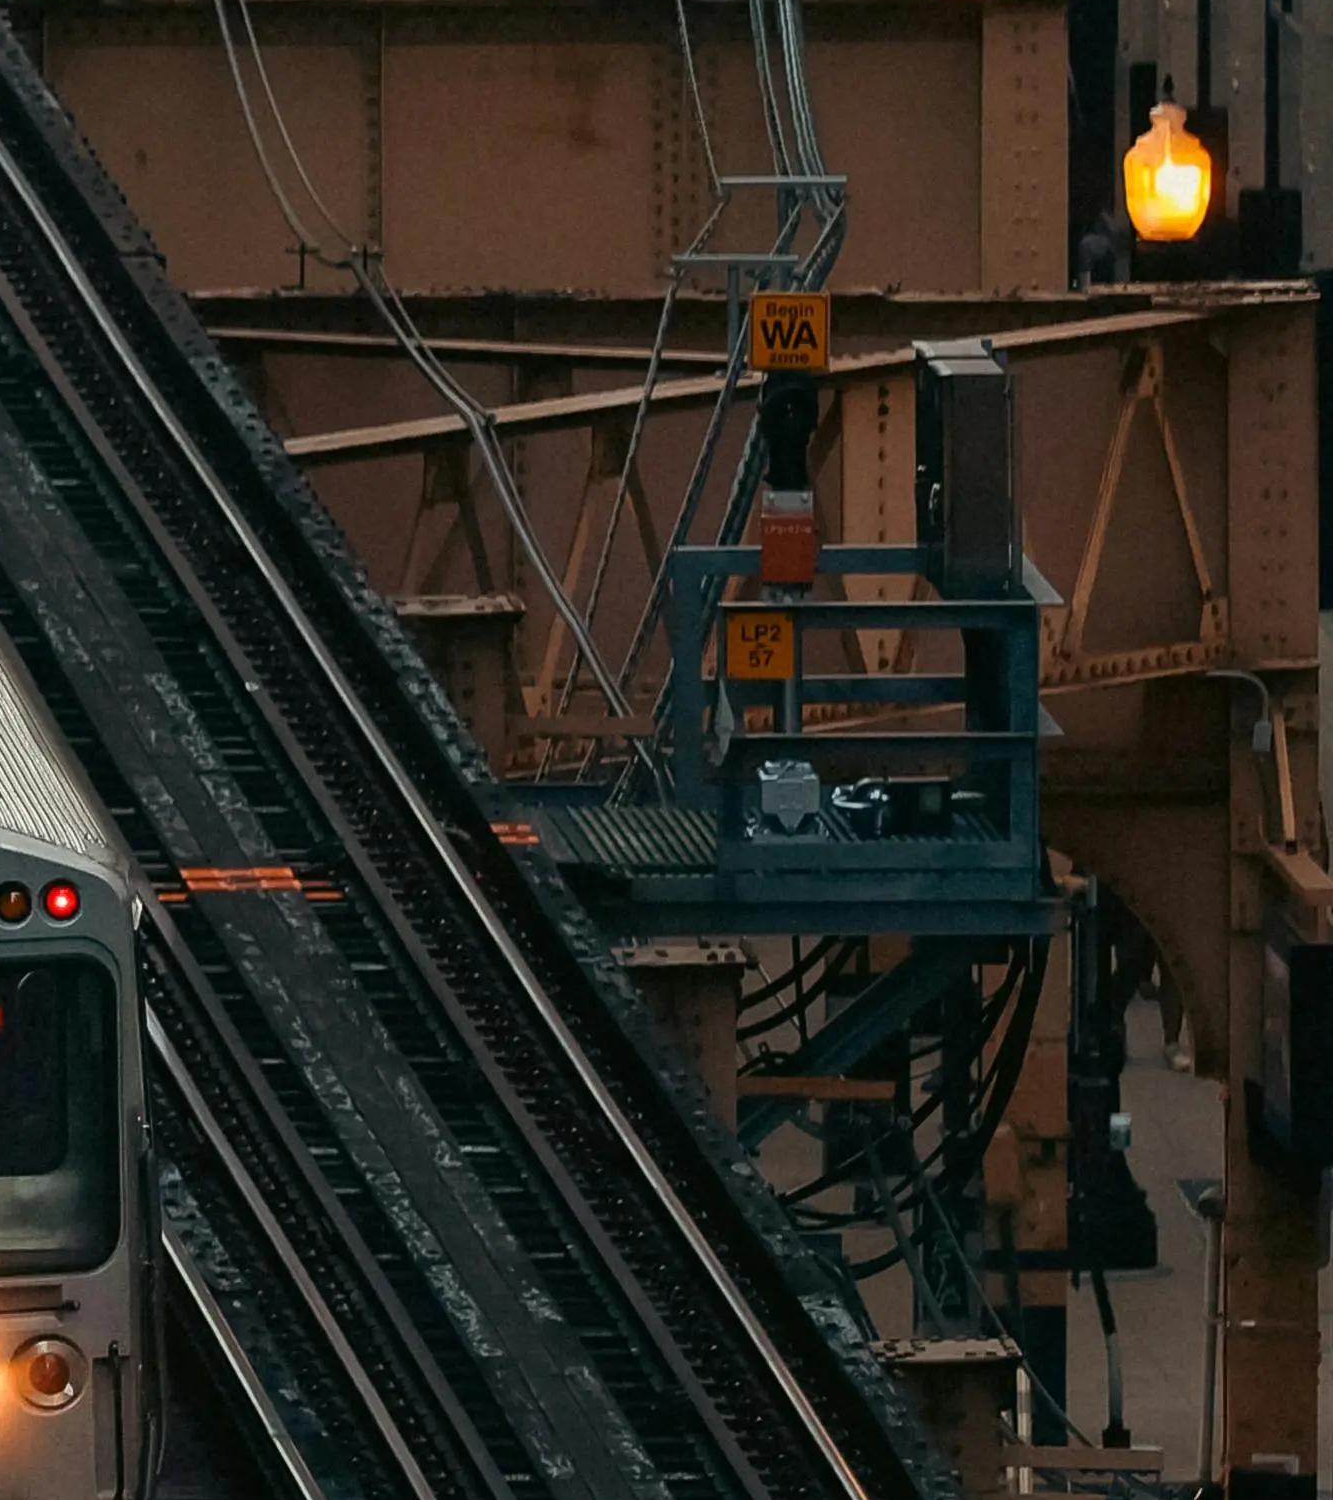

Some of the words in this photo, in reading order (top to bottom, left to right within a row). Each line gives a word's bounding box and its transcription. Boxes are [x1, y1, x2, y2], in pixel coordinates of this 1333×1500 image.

[760, 319, 818, 351] WA
[741, 623, 782, 643] LP2
[748, 650, 775, 669] 57
